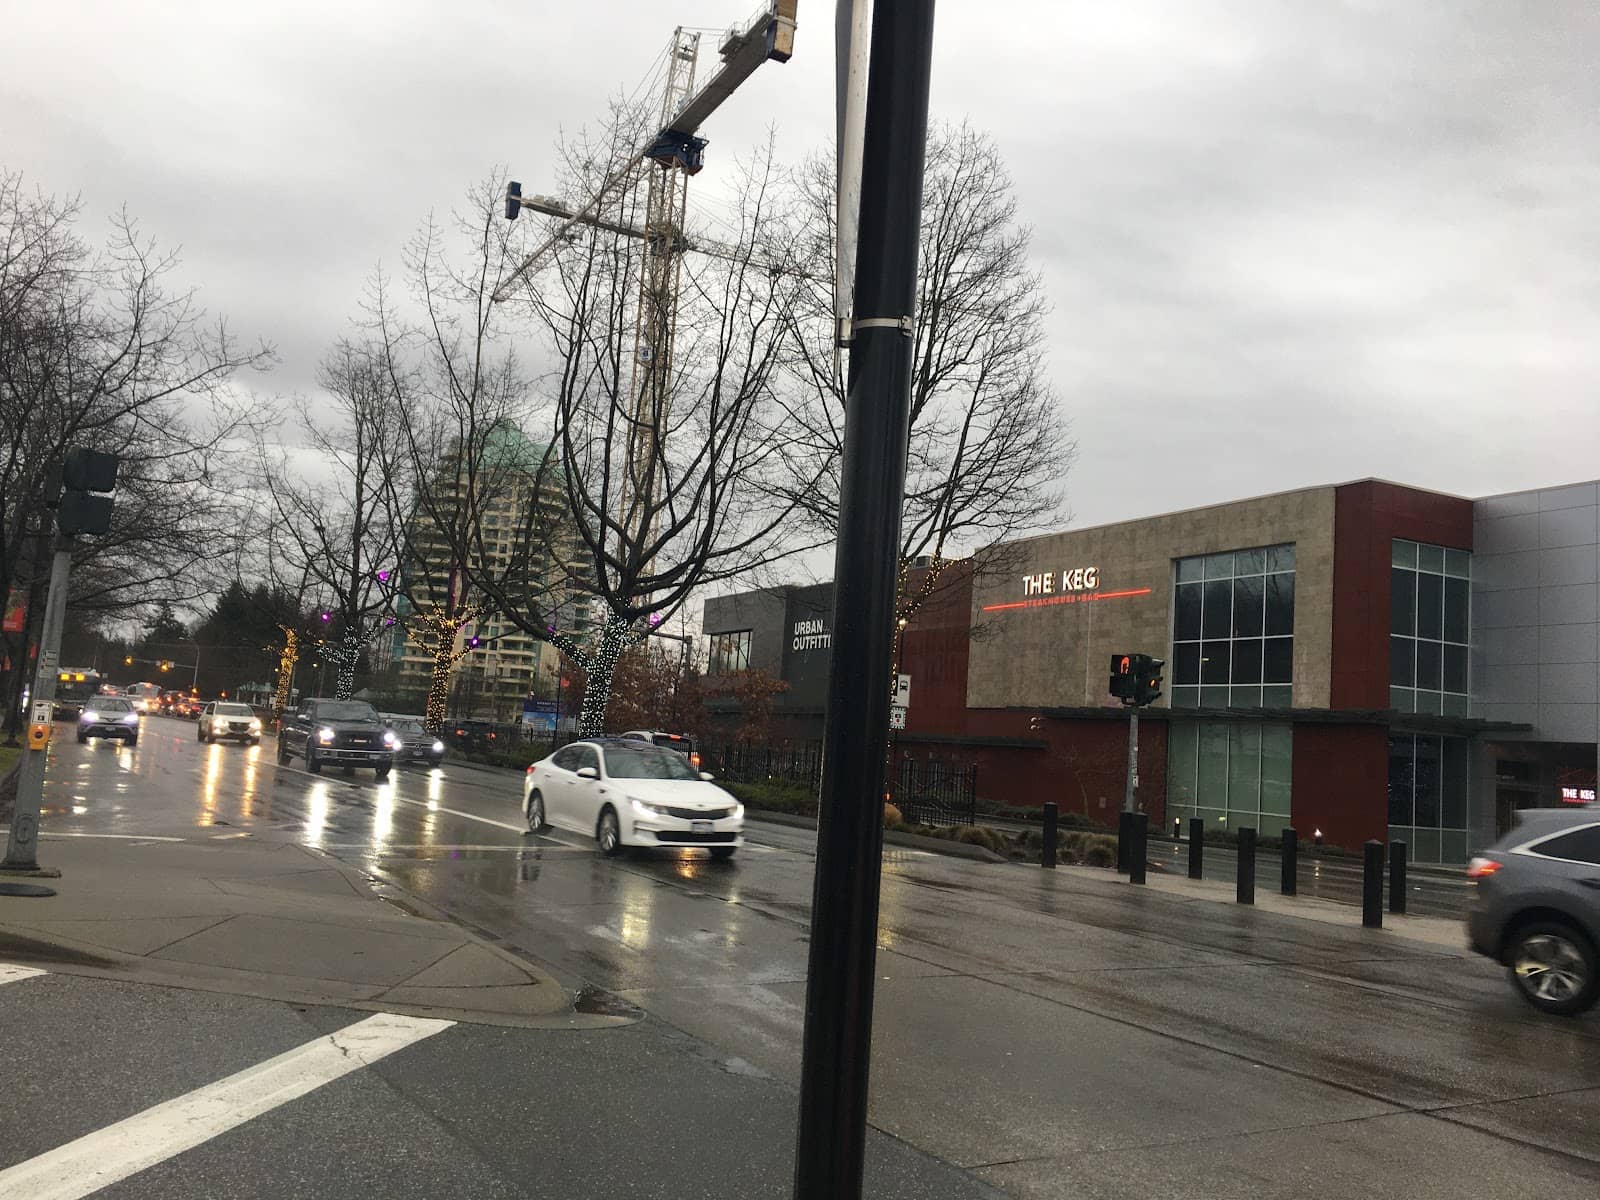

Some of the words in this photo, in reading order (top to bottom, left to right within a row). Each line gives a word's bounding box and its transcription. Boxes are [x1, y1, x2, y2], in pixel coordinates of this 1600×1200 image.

[1022, 572, 1055, 596] THE
[1062, 566, 1100, 591] KEG
[794, 620, 823, 635] URBAN
[1562, 788, 1578, 799] THE
[1580, 789, 1595, 800] KEG
